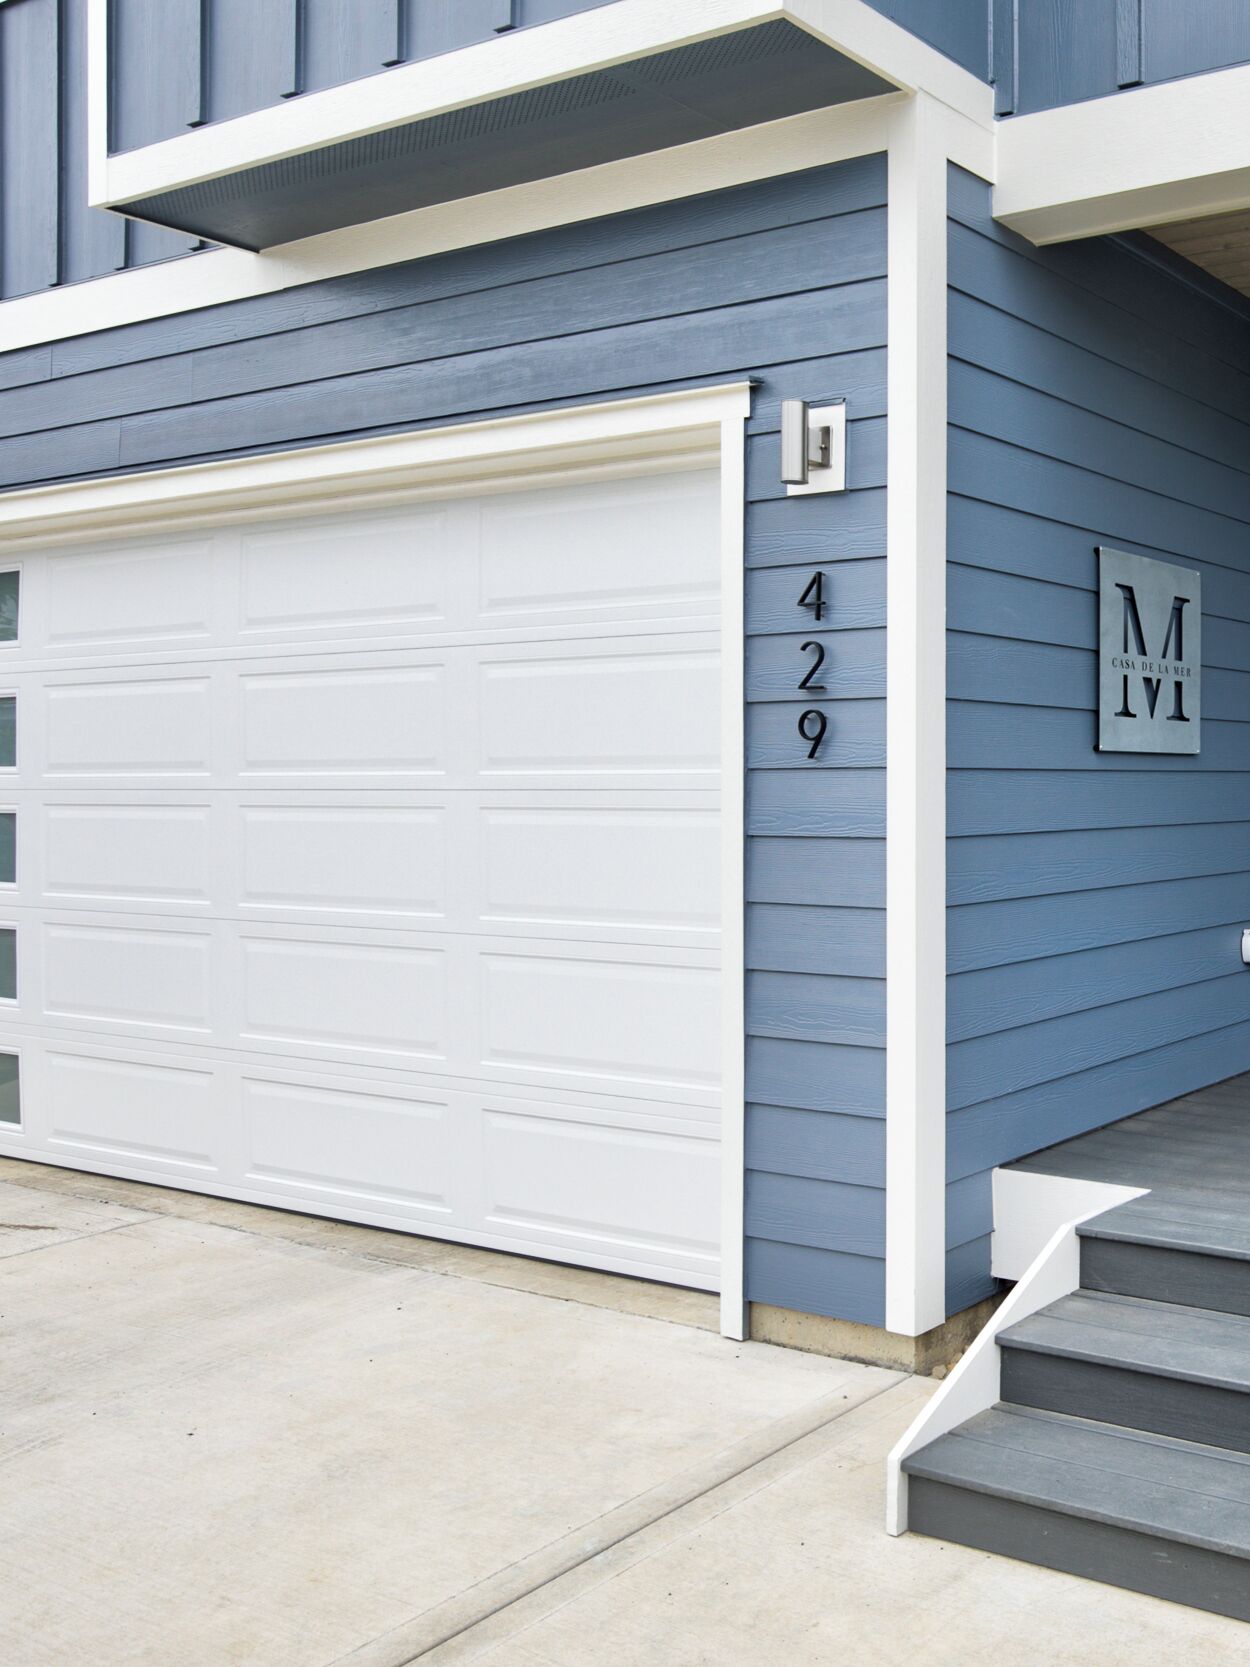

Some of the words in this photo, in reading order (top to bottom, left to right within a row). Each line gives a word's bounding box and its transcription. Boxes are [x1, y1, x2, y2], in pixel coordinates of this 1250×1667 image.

[1112, 657, 1135, 671] CASA
[1142, 661, 1154, 673] DE
[1158, 664, 1169, 675] LA
[1173, 666, 1192, 678] MER
